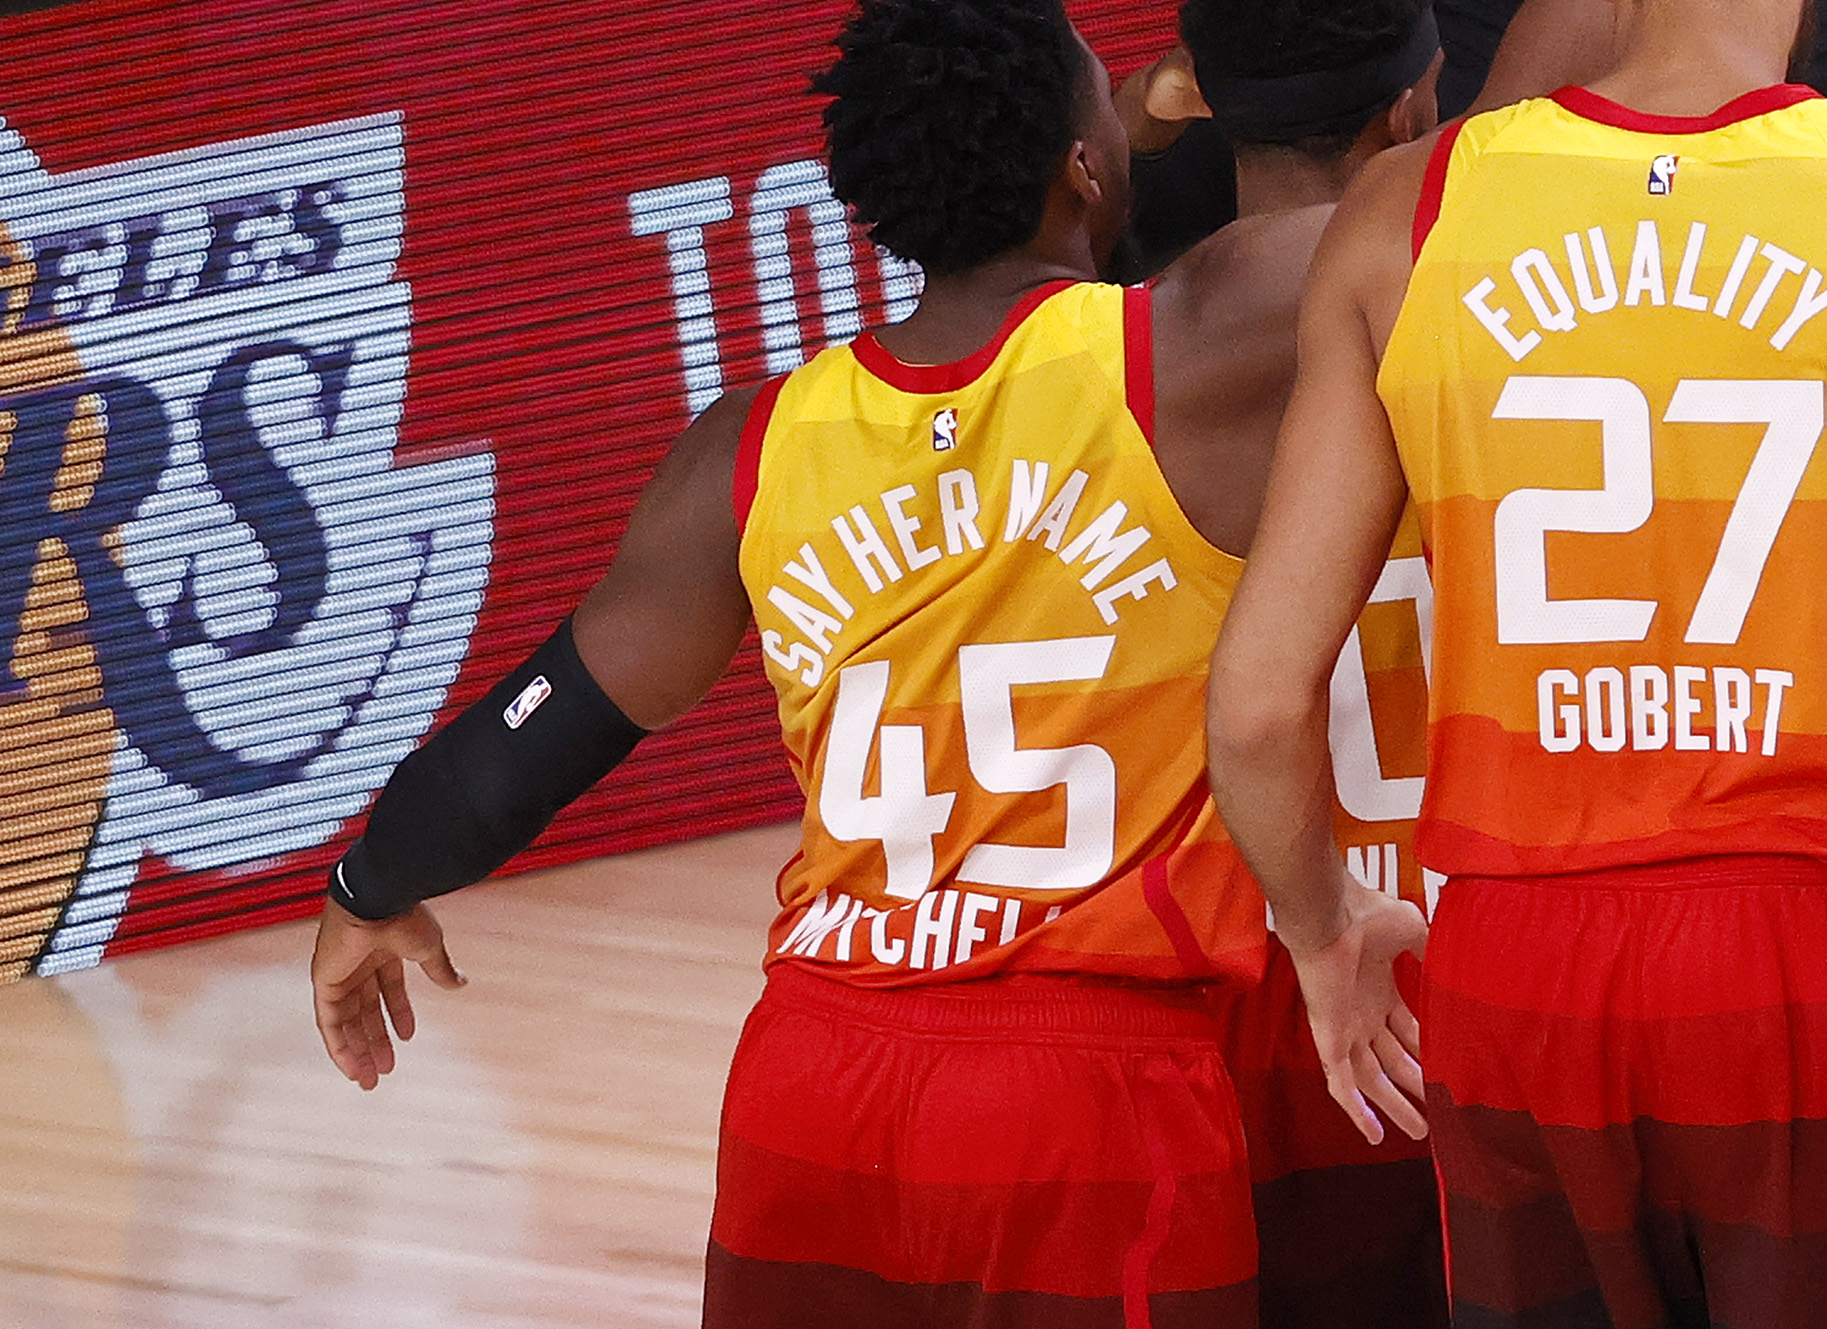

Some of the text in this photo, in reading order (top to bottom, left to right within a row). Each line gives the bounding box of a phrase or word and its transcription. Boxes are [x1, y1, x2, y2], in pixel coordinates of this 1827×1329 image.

[628, 159, 925, 422] TO
[762, 459, 1179, 689] SAY HER NAME
[1491, 374, 1827, 645] 27
[818, 635, 1117, 901] 45
[1537, 665, 1794, 757] GOBERT
[775, 886, 1062, 972] MITCHEL
